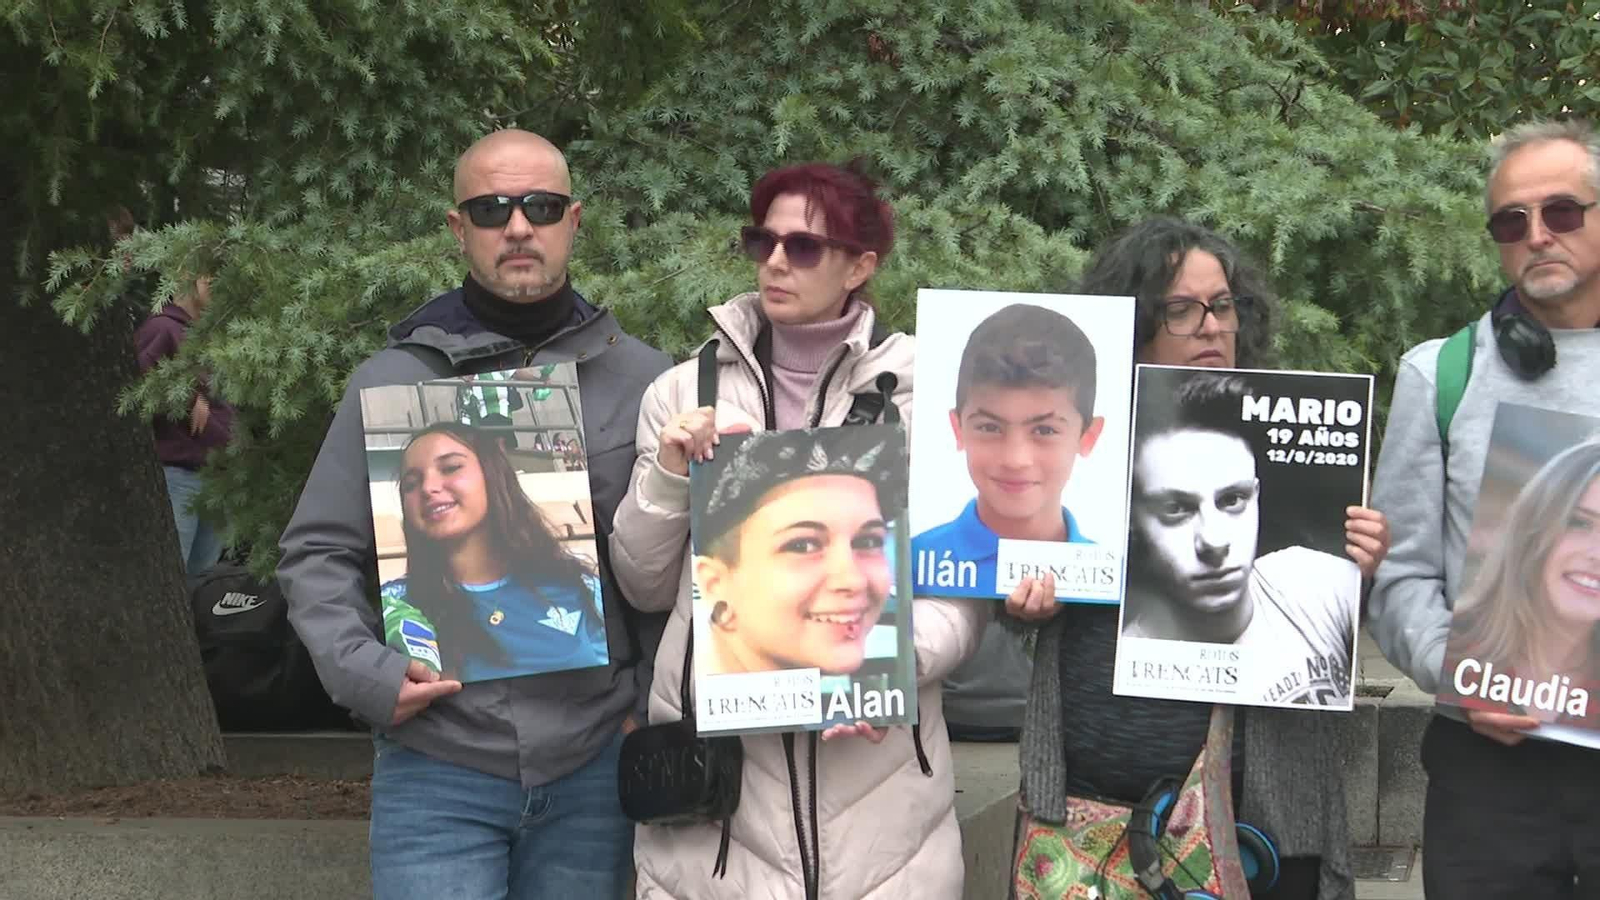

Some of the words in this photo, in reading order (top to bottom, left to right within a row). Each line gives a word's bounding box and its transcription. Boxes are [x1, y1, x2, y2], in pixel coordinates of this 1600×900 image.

[1242, 395, 1362, 426] MARIO
[1266, 428, 1293, 444] 19
[1298, 426, 1359, 448] AÑOS
[917, 550, 977, 588] Ilán
[220, 592, 259, 608] NIKE
[1129, 660, 1238, 685] TRENCATS
[826, 682, 904, 720] Alan
[1454, 658, 1589, 717] Claudia
[707, 690, 815, 715] TRENCATS
